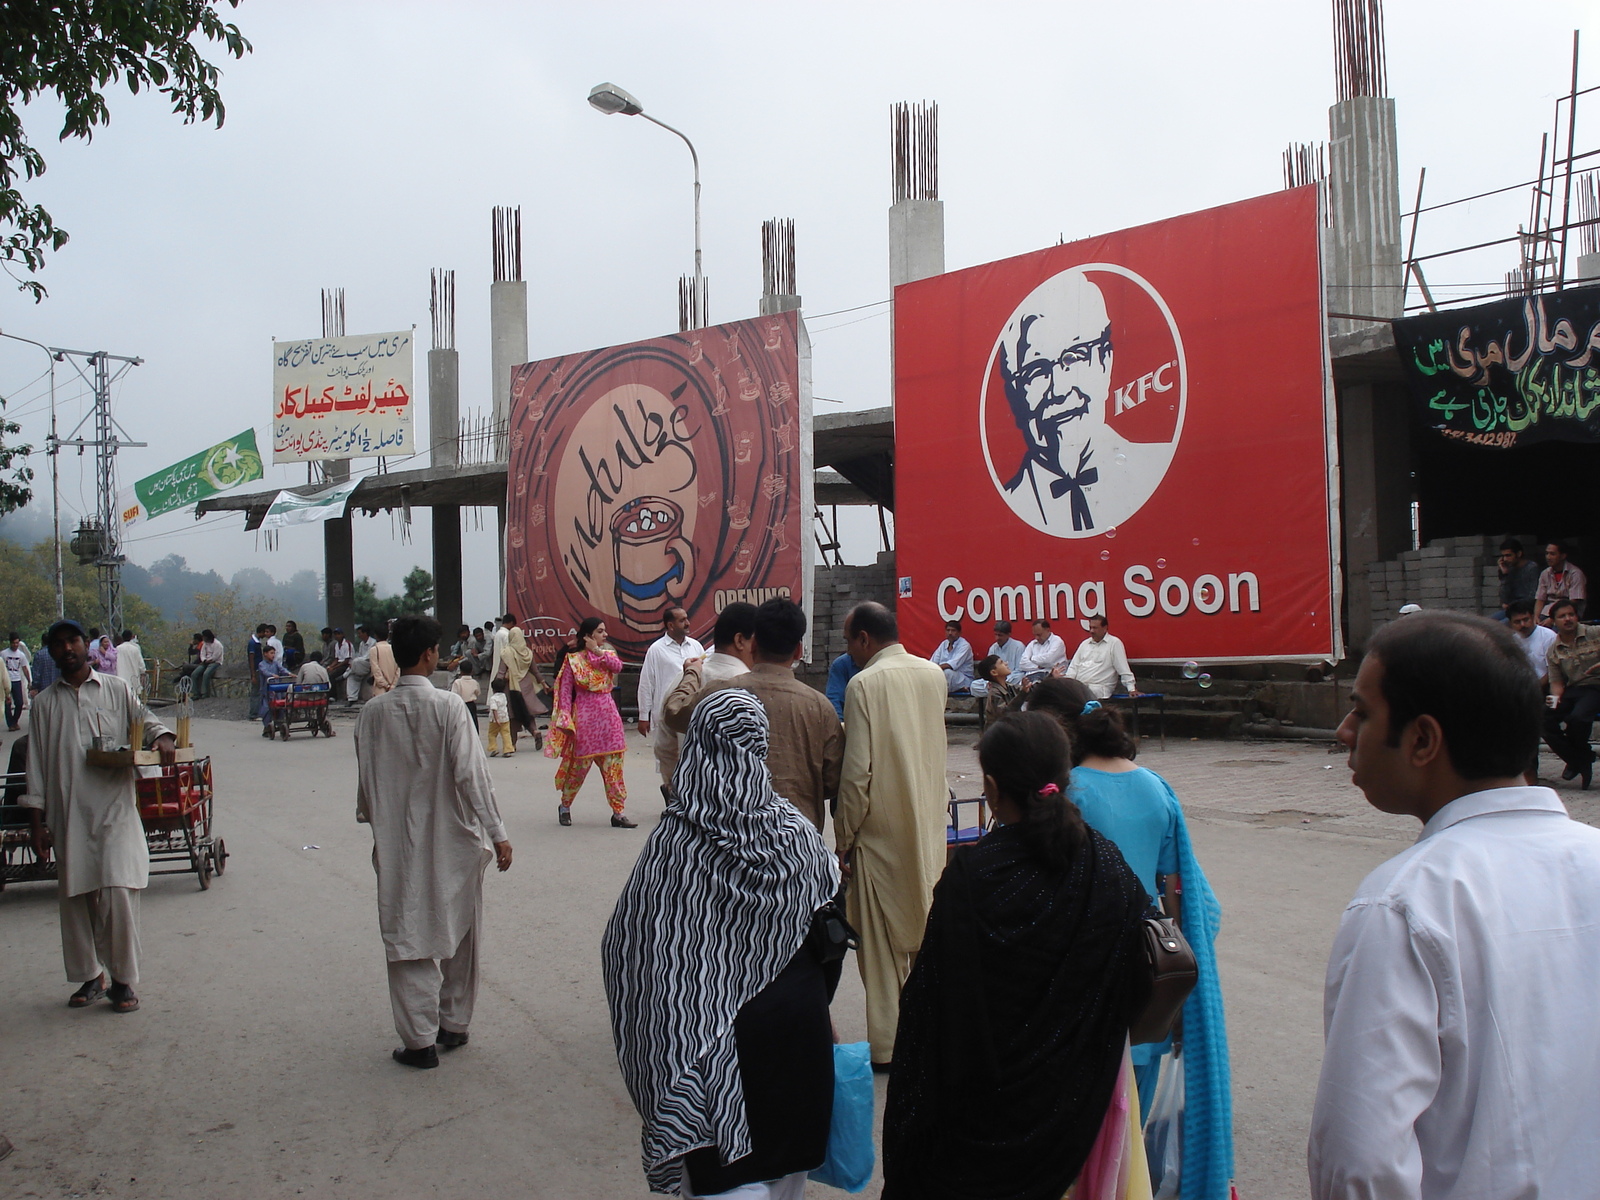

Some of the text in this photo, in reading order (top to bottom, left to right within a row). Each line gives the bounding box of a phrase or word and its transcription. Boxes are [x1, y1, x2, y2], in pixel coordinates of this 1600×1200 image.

[278, 347, 293, 367] گاہ
[292, 341, 312, 367] تفریح
[347, 345, 368, 360] سب
[368, 338, 387, 357] میں
[386, 336, 408, 357] مری
[1413, 338, 1450, 375] میں
[365, 365, 374, 374] اور
[275, 384, 301, 419] کار
[295, 384, 335, 419] کیبل
[1114, 364, 1174, 417] KFC
[1429, 389, 1470, 420] ہے
[302, 429, 328, 452] پنڈی
[373, 429, 403, 451] فاصلہ
[123, 505, 139, 522] SUFI
[937, 564, 1260, 631] Coming Soon
[522, 628, 577, 637] UPOLA
[532, 644, 555, 655] Project
